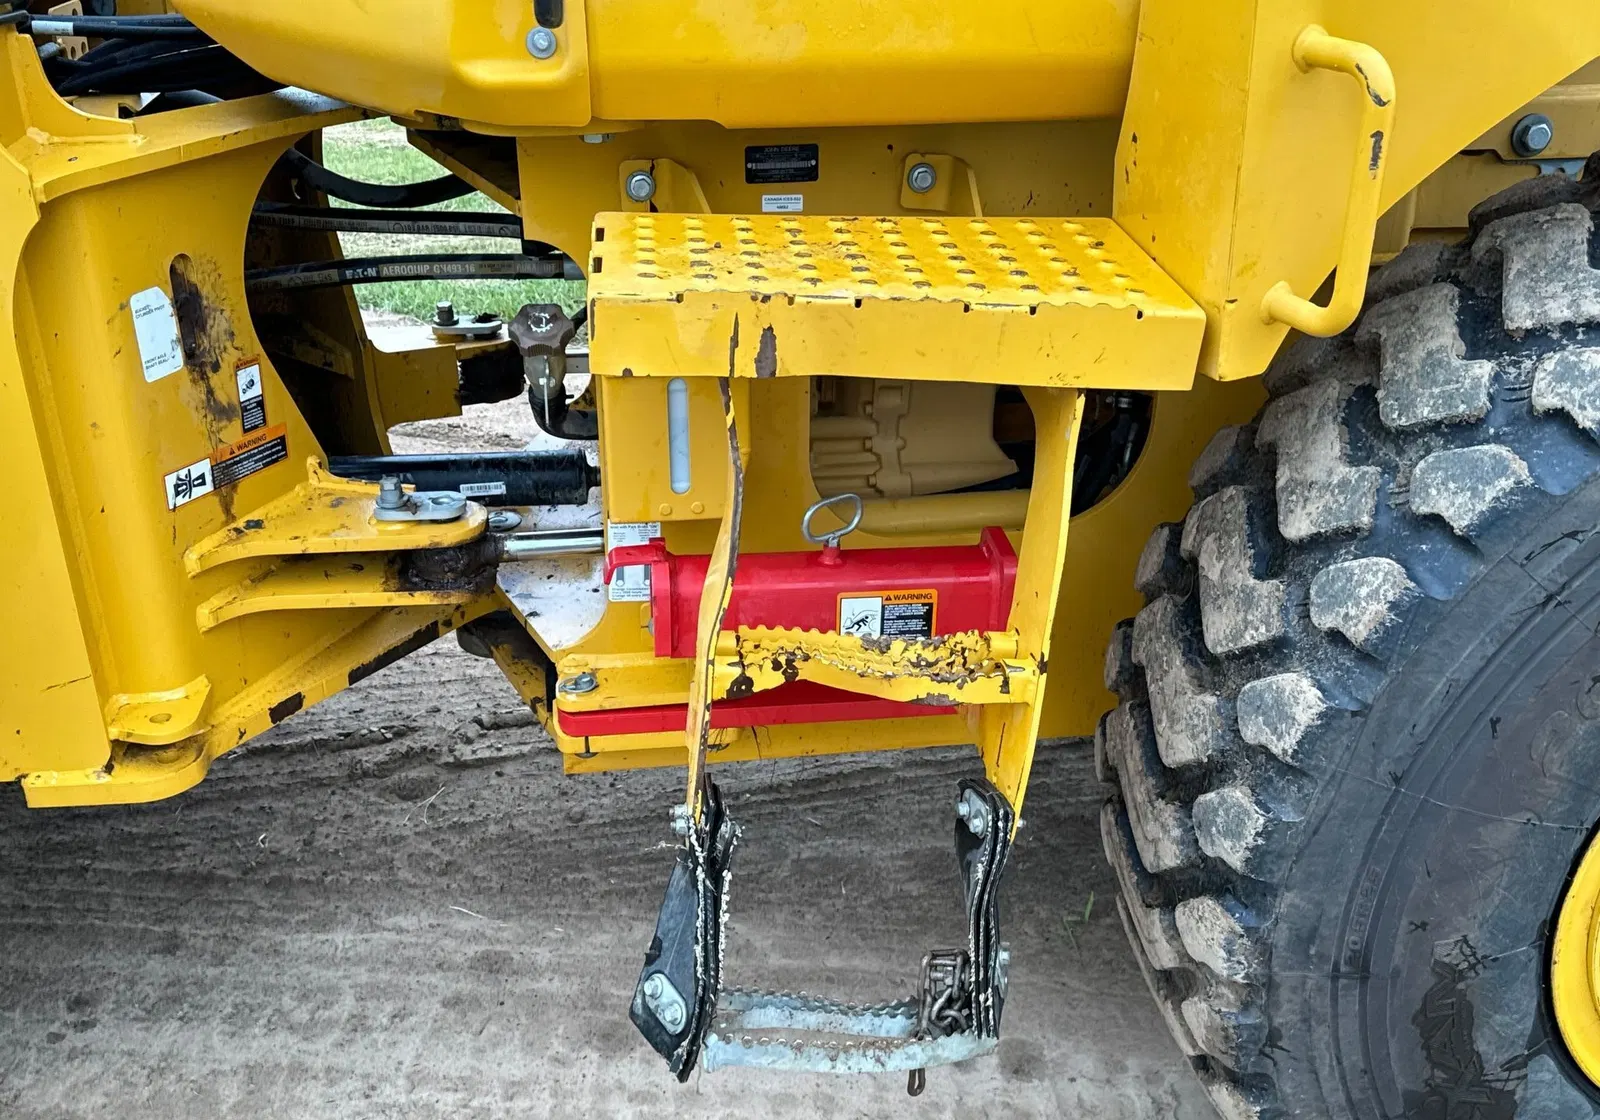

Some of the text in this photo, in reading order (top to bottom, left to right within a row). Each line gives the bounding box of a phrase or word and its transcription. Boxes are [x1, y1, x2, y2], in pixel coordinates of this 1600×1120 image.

[382, 263, 430, 276] AEROQUIP
[237, 433, 267, 452] WARNING
[893, 592, 933, 601] WARNING
